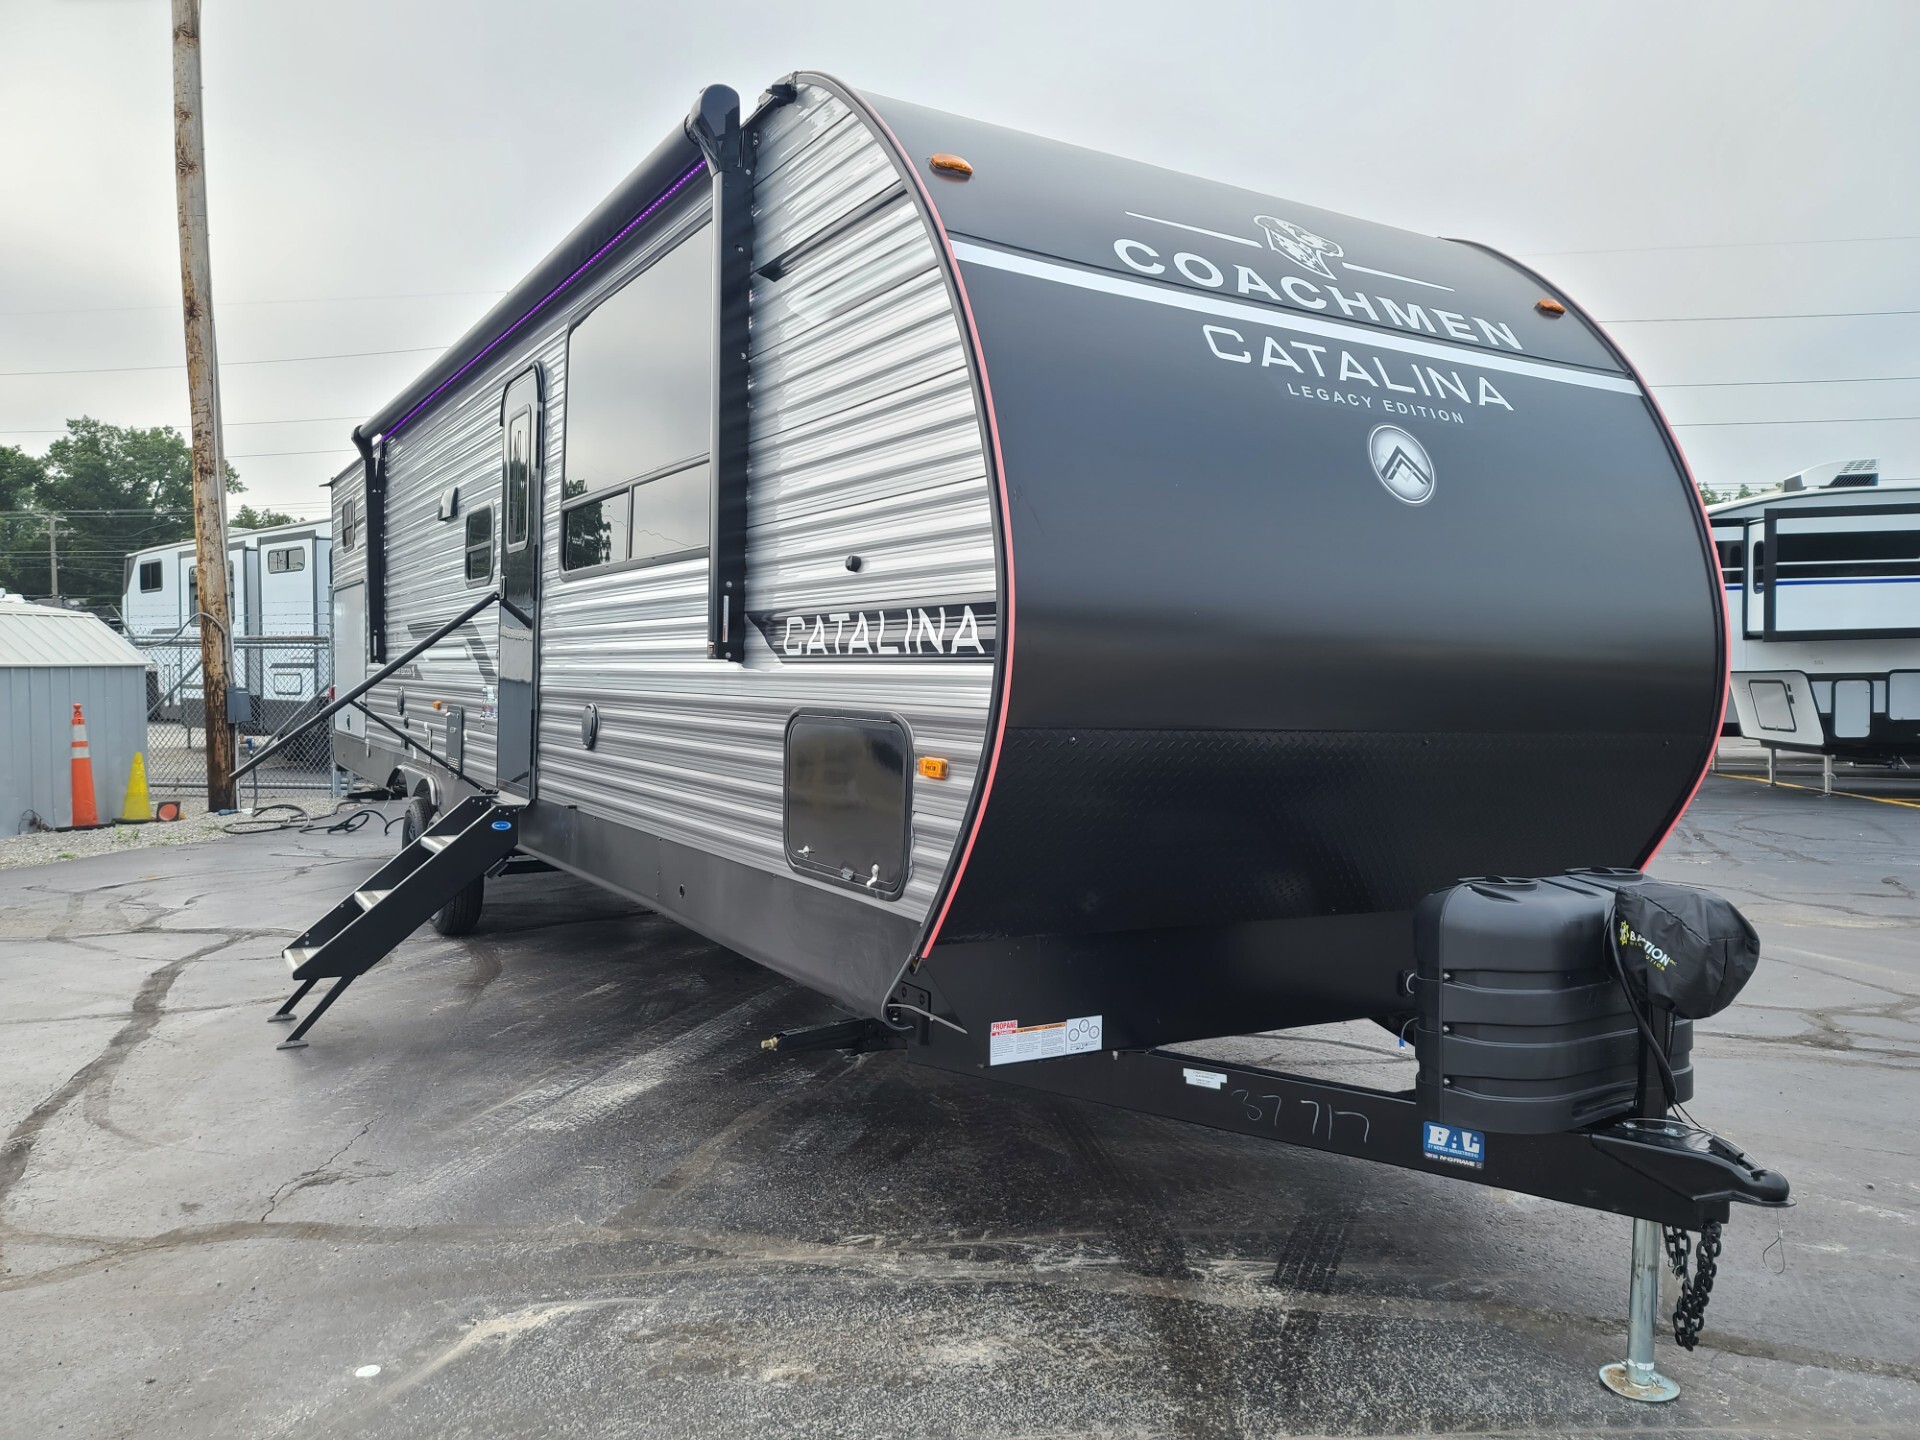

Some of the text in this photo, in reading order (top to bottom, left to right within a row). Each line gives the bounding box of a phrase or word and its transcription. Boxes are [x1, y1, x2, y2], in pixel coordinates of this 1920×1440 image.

[1113, 238, 1523, 350] COACHMEN
[1203, 324, 1514, 411] CATALINA
[1287, 383, 1465, 424] LEGACY EDITION
[783, 605, 986, 655] CATALINA
[992, 1021, 1017, 1030] PROPANE
